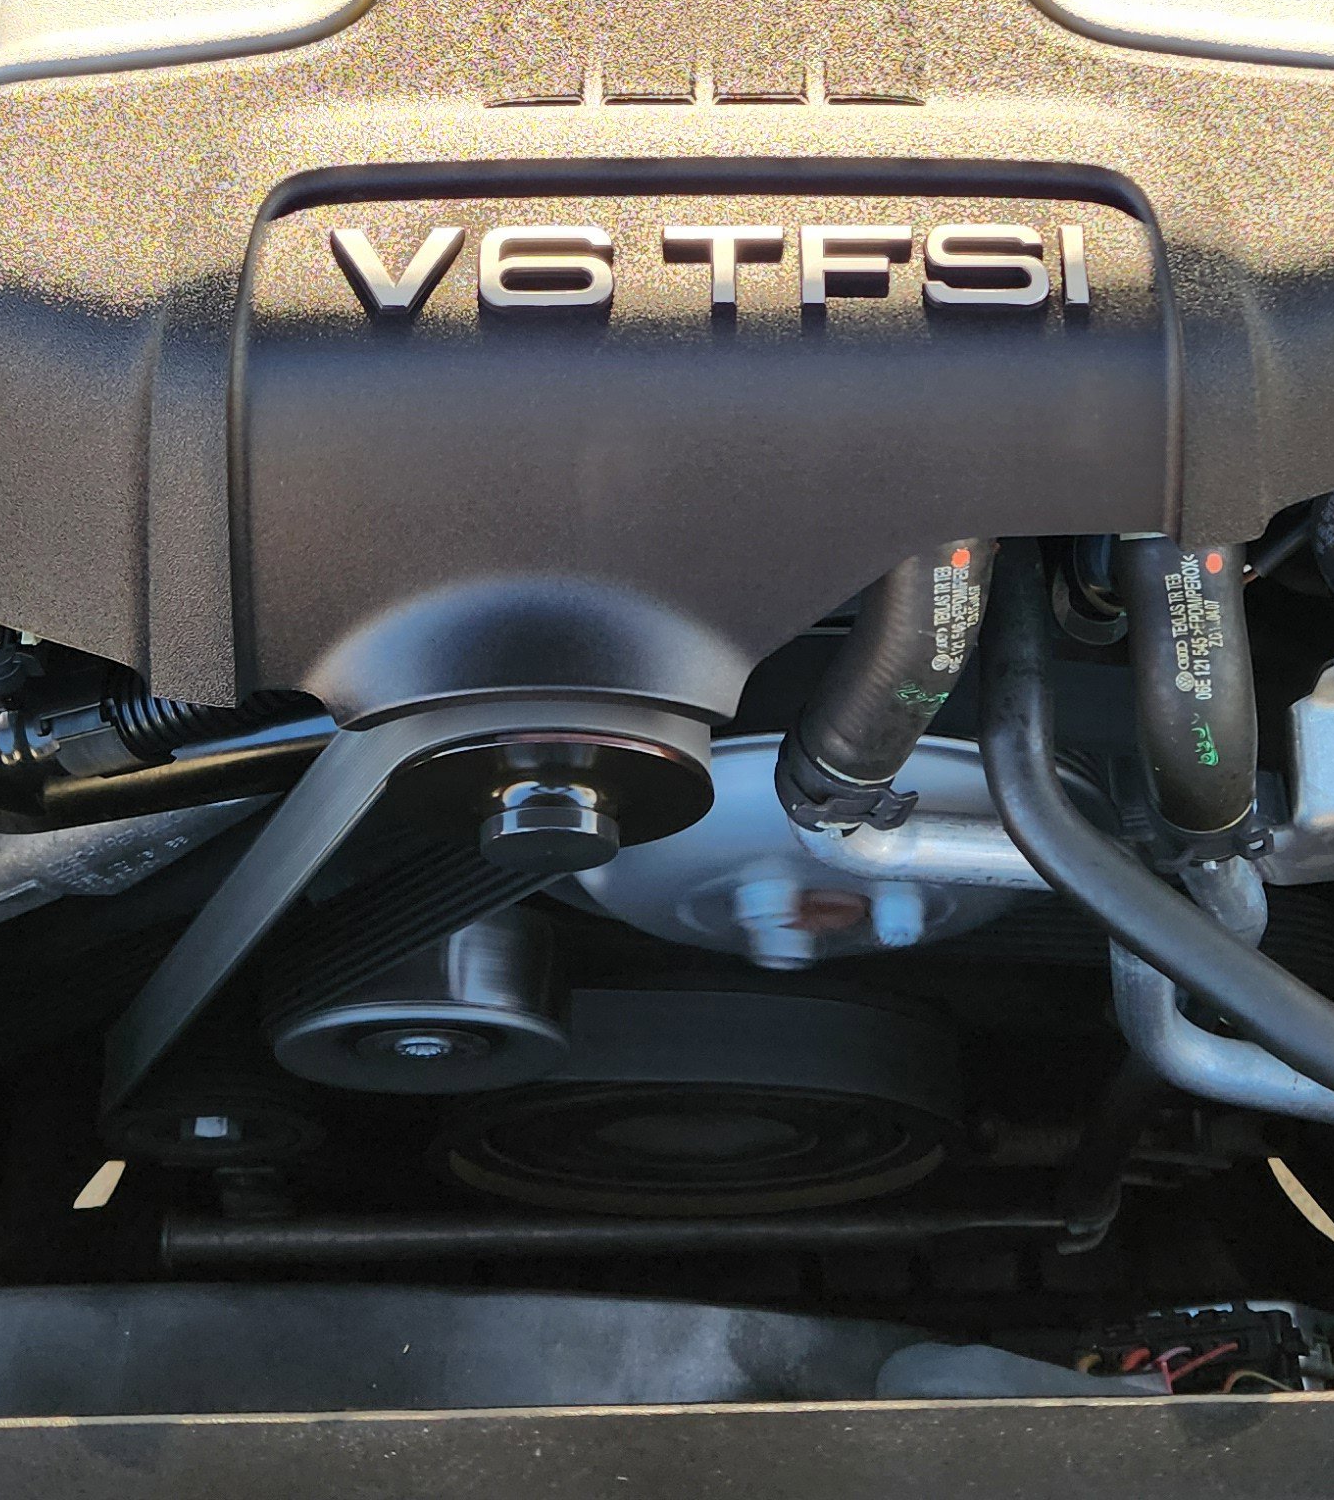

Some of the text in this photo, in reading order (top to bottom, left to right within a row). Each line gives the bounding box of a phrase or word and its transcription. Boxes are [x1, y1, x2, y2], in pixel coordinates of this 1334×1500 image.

[329, 224, 1090, 310] V6 TFSI
[1169, 590, 1184, 604] TR
[1172, 603, 1189, 639] TEKLAS
[1192, 659, 1211, 677] 121
[1195, 678, 1213, 701] 06E
